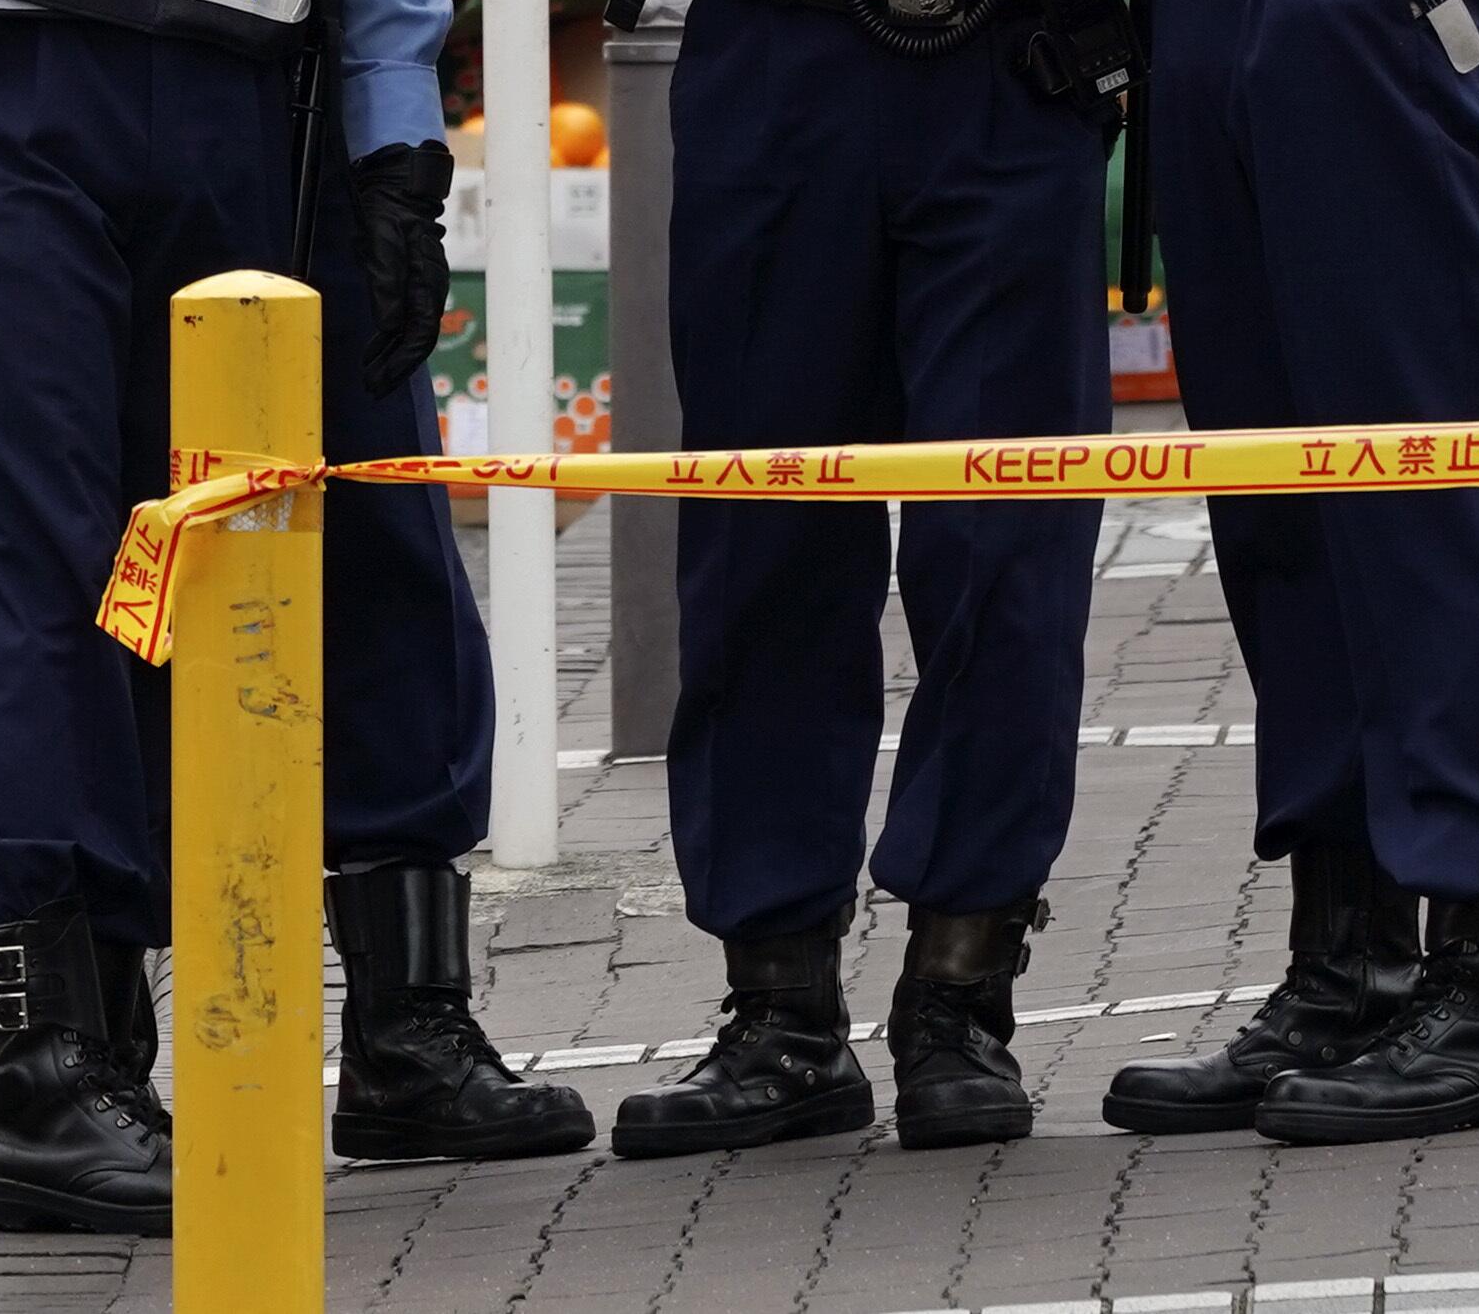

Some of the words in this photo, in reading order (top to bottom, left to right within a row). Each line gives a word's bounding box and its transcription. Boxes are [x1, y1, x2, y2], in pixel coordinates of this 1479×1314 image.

[665, 449, 856, 486] 立入禁止
[964, 445, 1090, 484] KEEP
[1104, 442, 1206, 481] OUT
